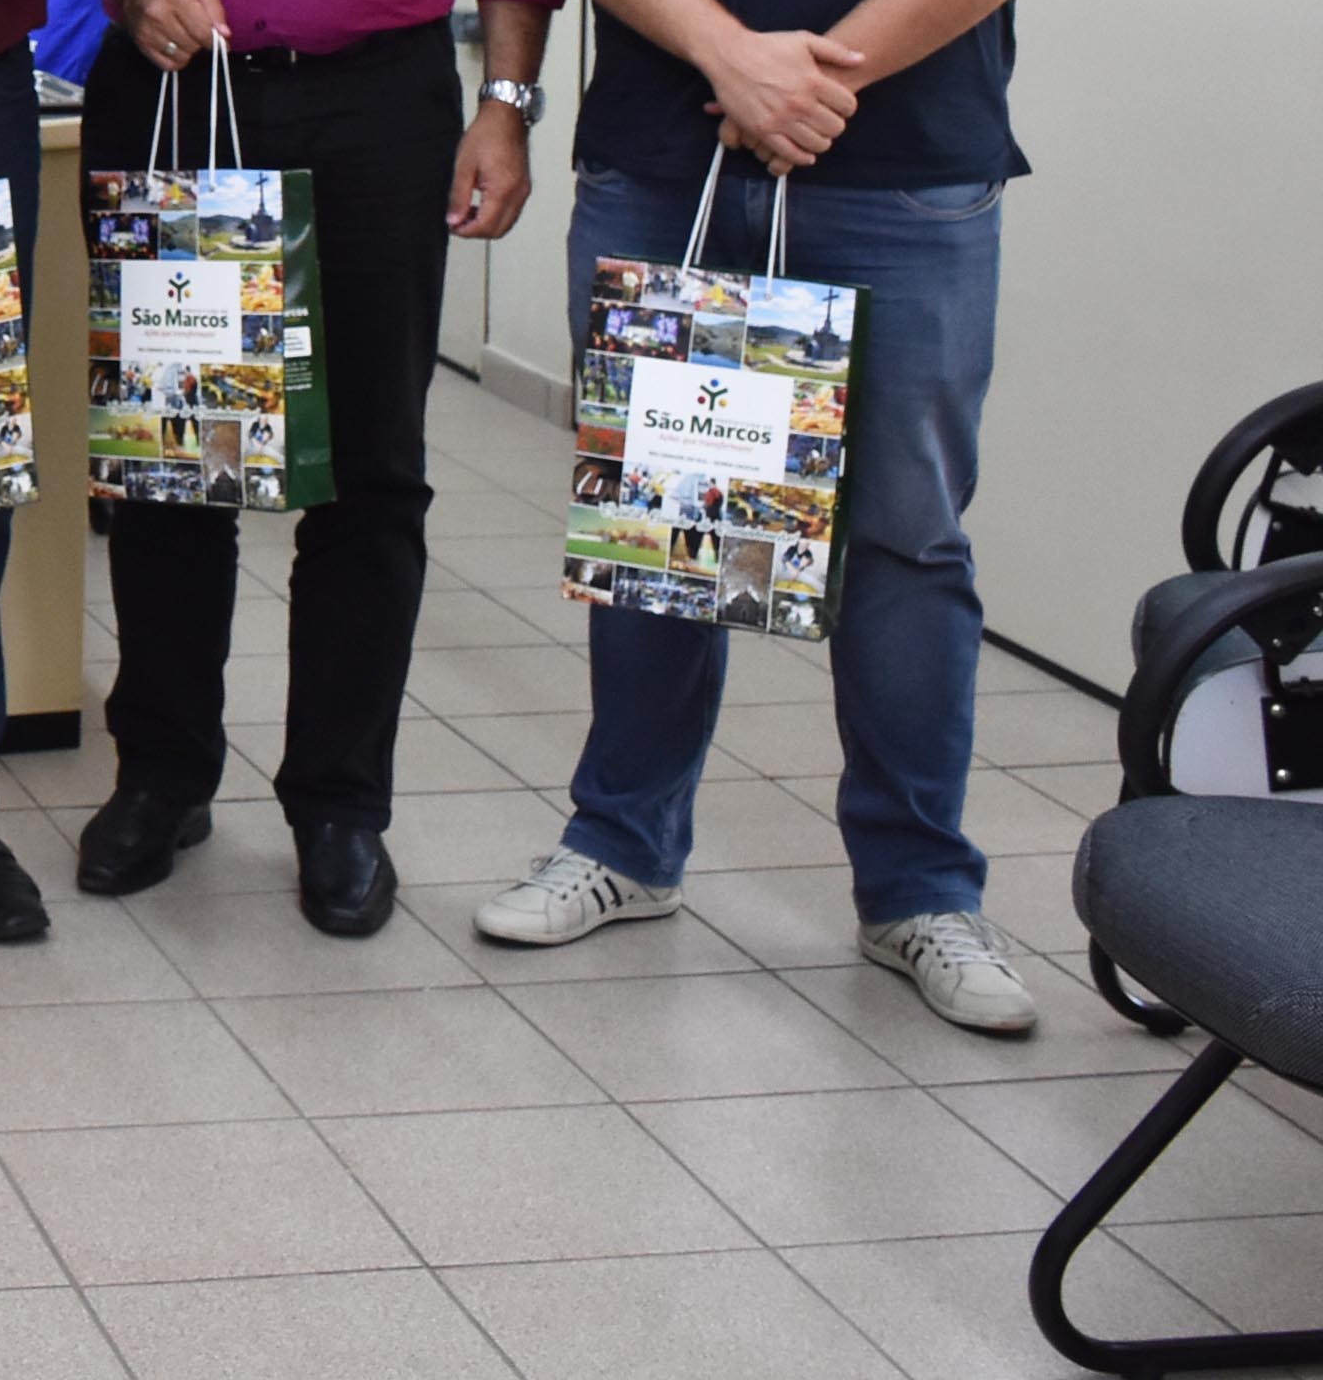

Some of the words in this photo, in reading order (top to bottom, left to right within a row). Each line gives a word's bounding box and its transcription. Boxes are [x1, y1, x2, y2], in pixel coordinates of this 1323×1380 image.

[131, 308, 162, 326] São
[165, 308, 229, 328] Marcos
[643, 409, 684, 431] São
[690, 415, 772, 444] Marcos
